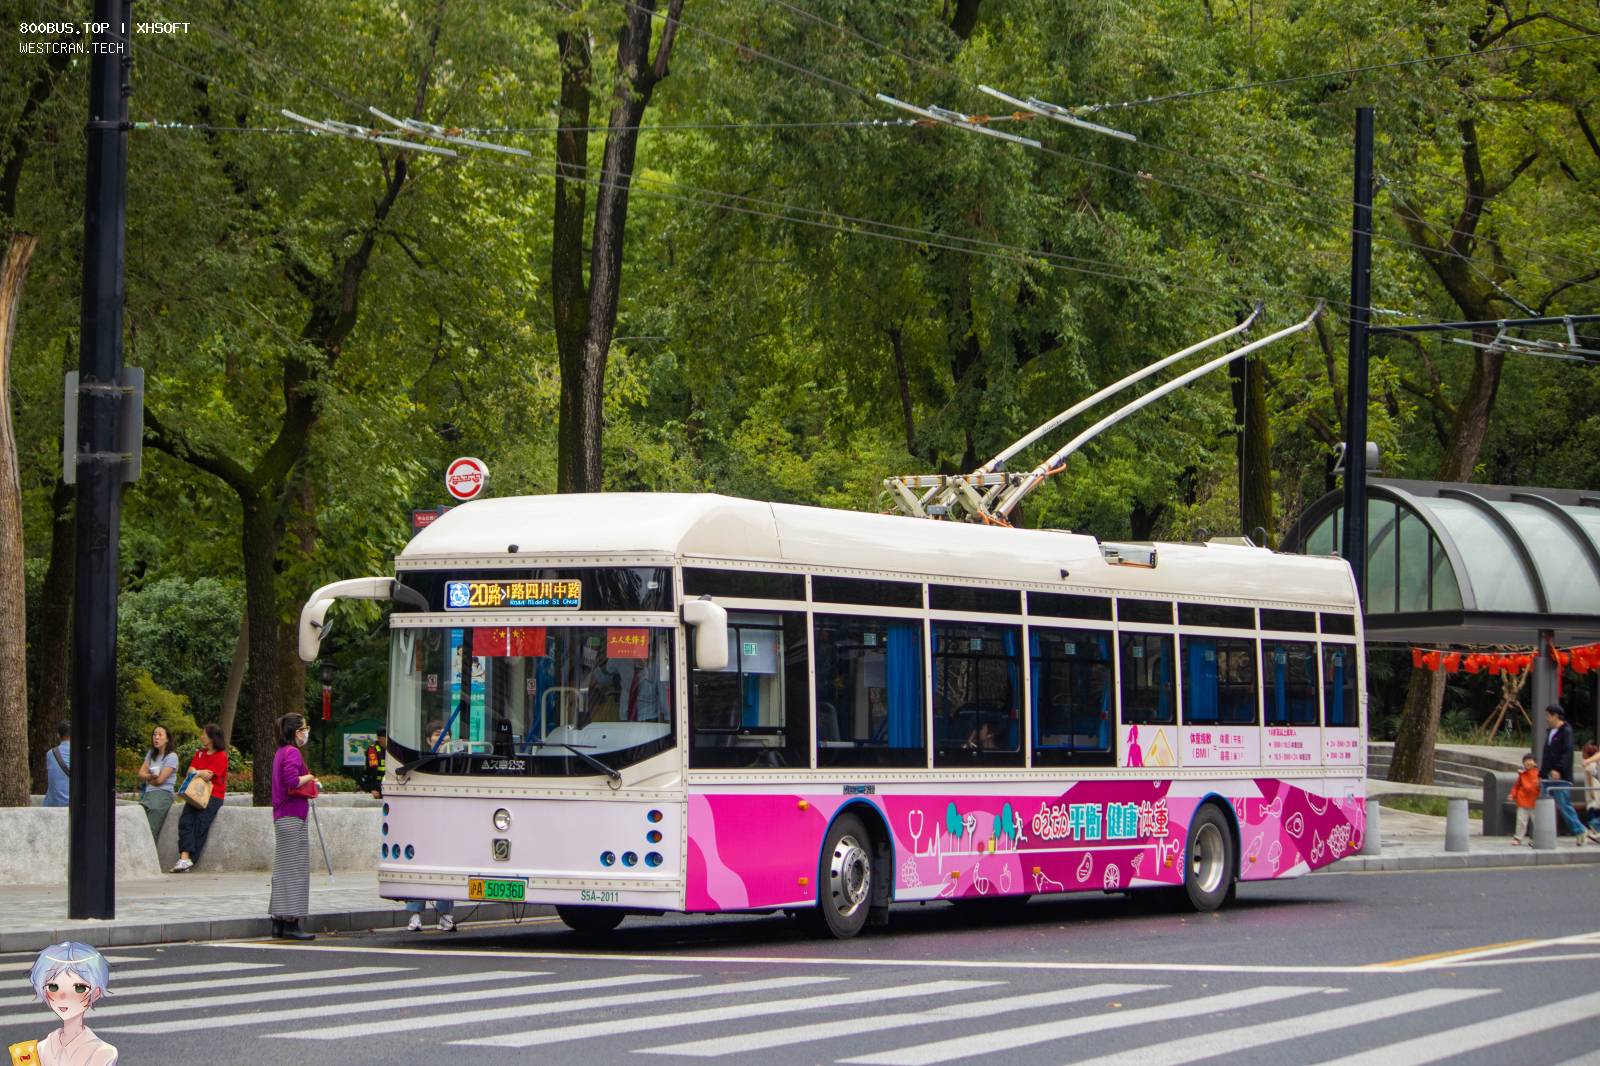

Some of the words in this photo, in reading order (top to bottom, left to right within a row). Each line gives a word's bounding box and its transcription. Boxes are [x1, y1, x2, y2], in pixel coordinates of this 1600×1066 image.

[469, 583, 501, 606] 20路
[506, 581, 580, 599] 路四川中路
[1032, 801, 1102, 840] 吃动平衡
[1106, 799, 1169, 840] 健康体重
[580, 889, 620, 903] S5A-2011
